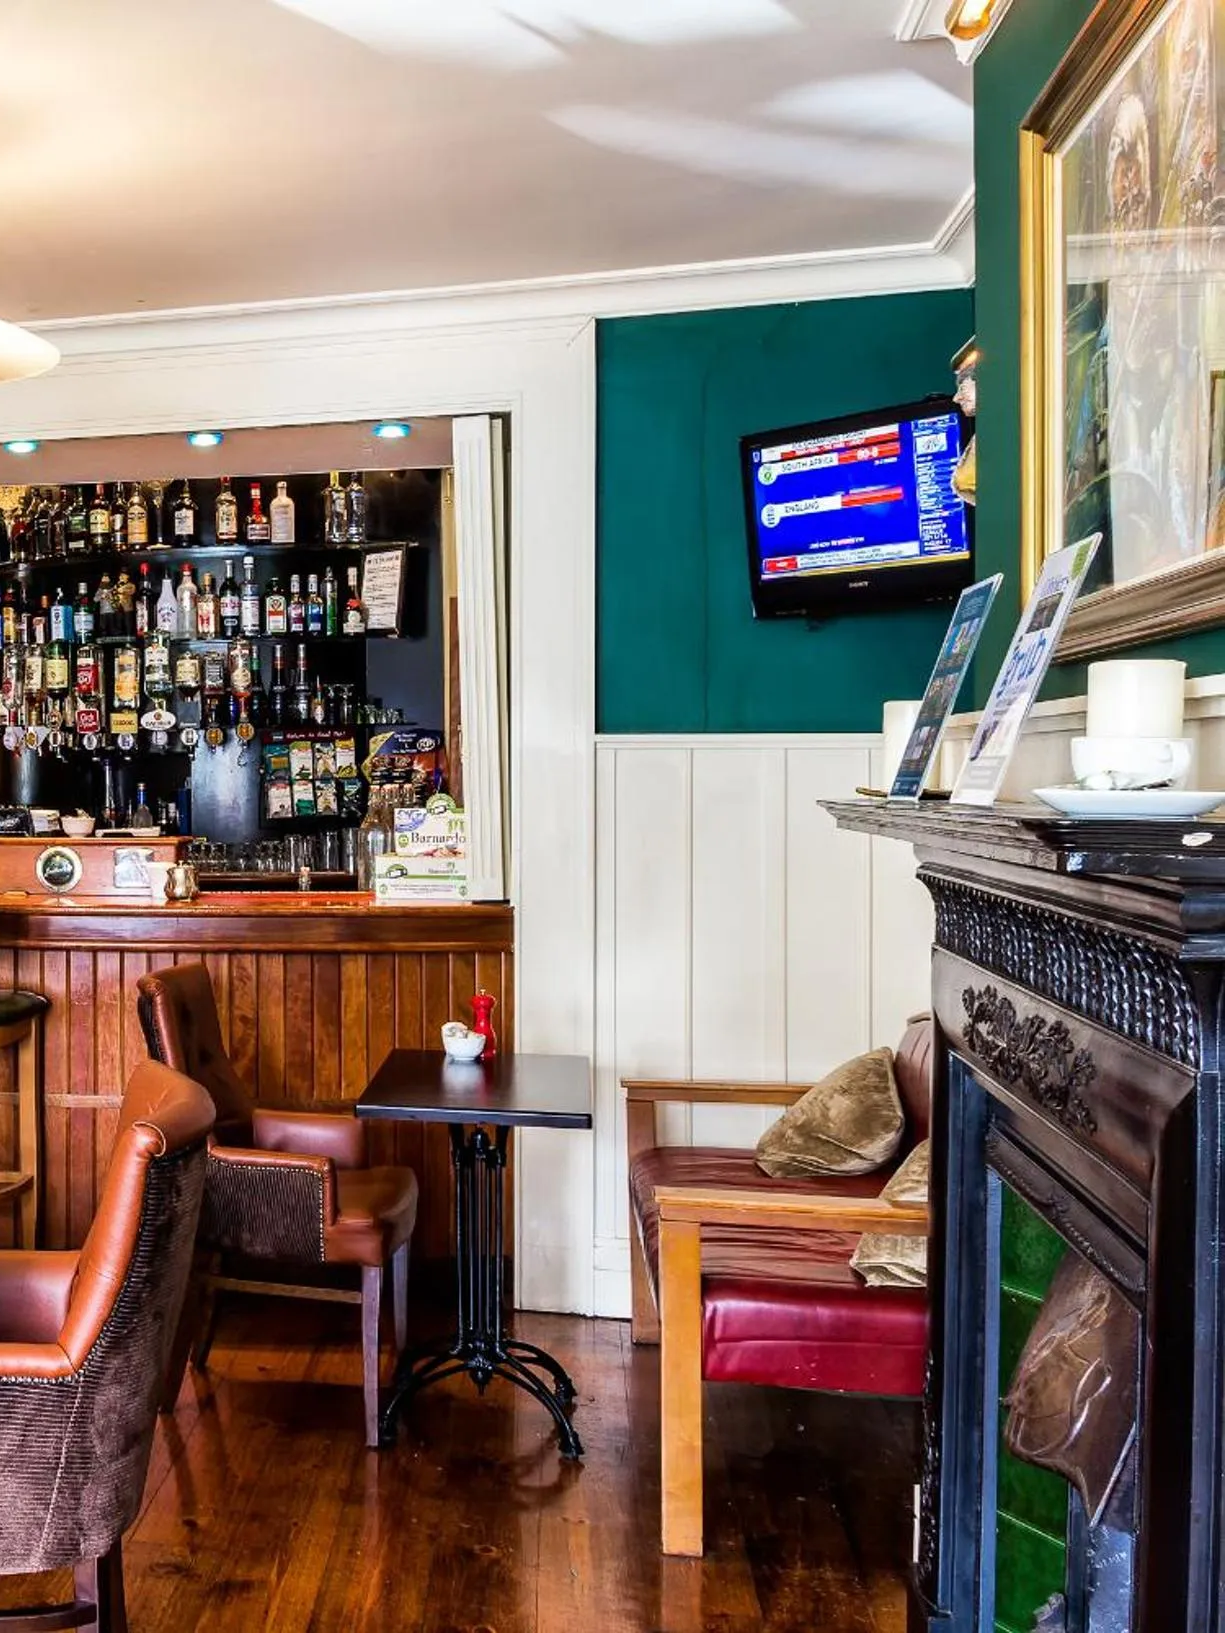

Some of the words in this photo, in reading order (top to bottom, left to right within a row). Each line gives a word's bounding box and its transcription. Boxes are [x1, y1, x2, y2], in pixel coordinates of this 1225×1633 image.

[781, 460, 807, 472] SOUTH
[809, 457, 834, 468] AFRICA
[785, 500, 820, 513] ENGLAND
